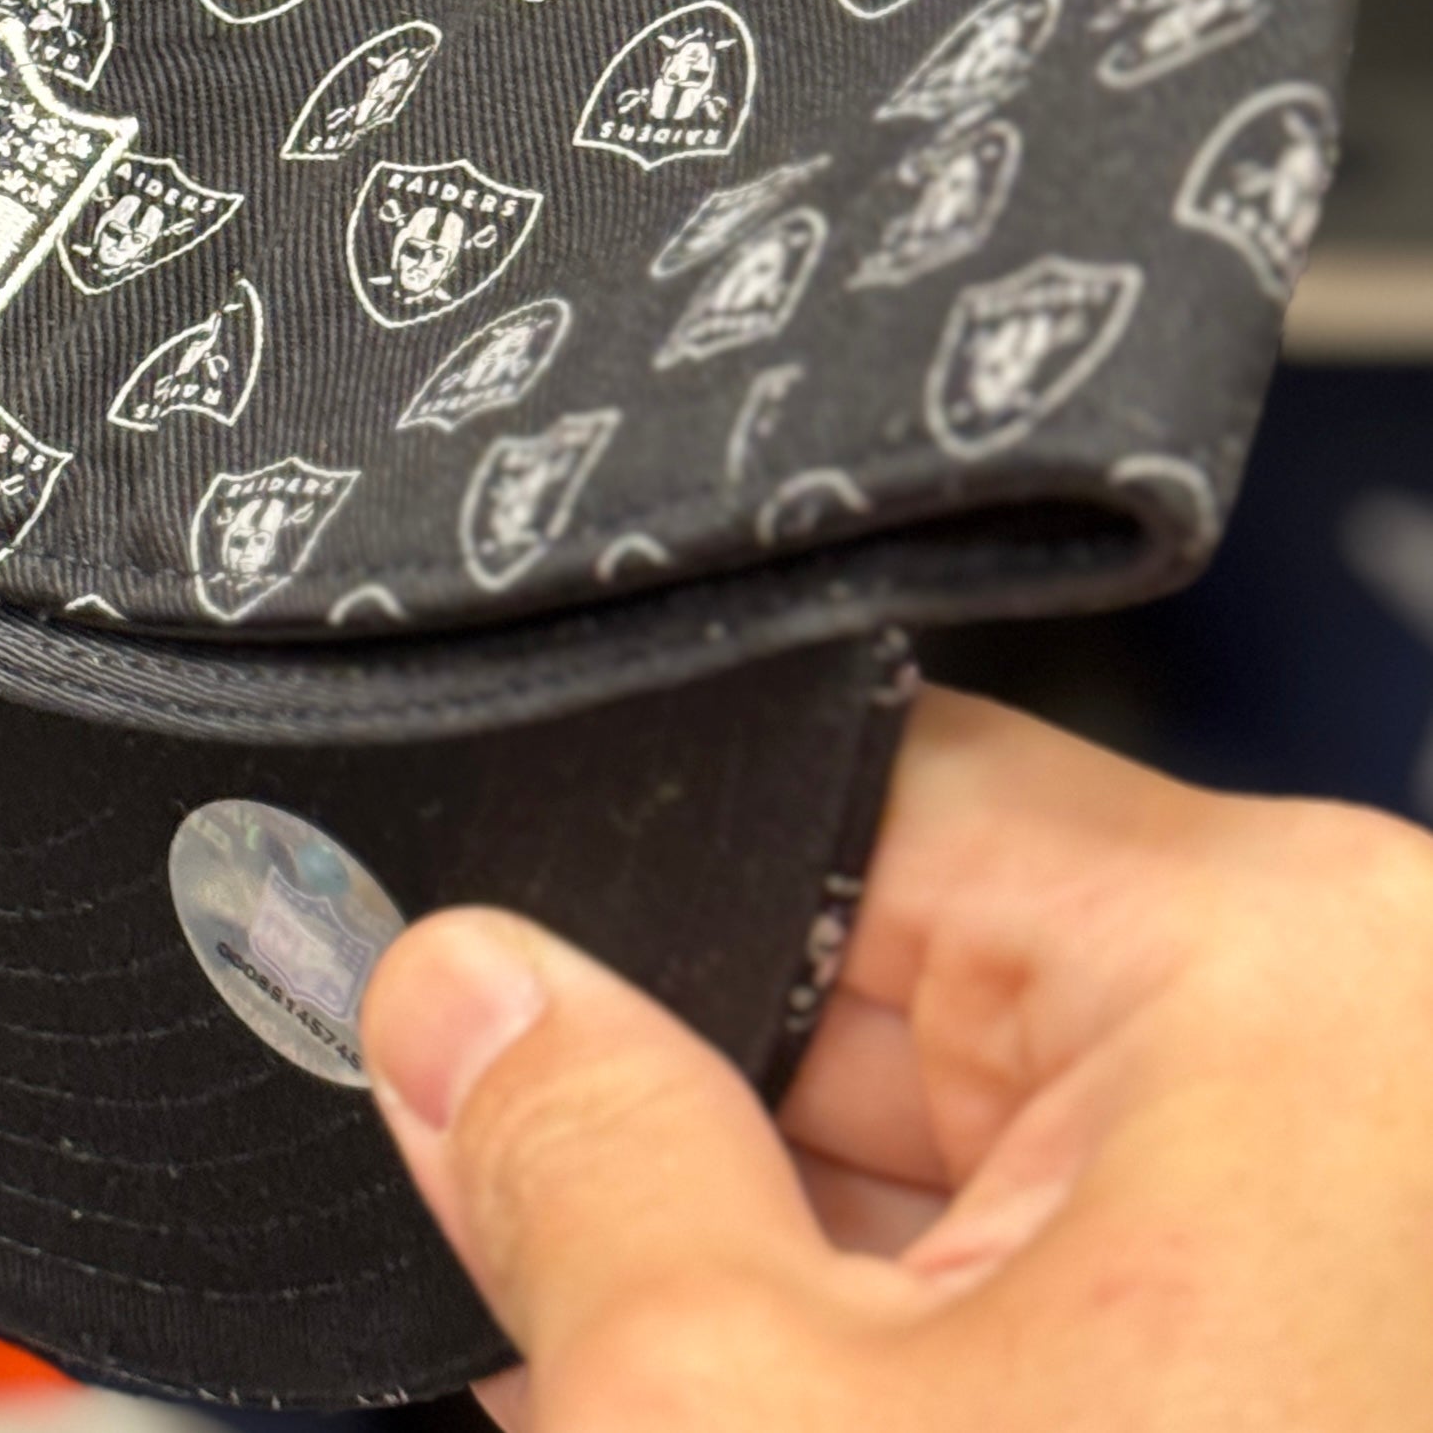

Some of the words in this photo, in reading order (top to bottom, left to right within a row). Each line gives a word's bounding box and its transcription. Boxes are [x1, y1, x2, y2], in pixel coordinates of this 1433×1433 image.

[600, 122, 723, 146] RAIDERS
[115, 162, 217, 213] AIDERS
[388, 174, 518, 216] RAIDERS
